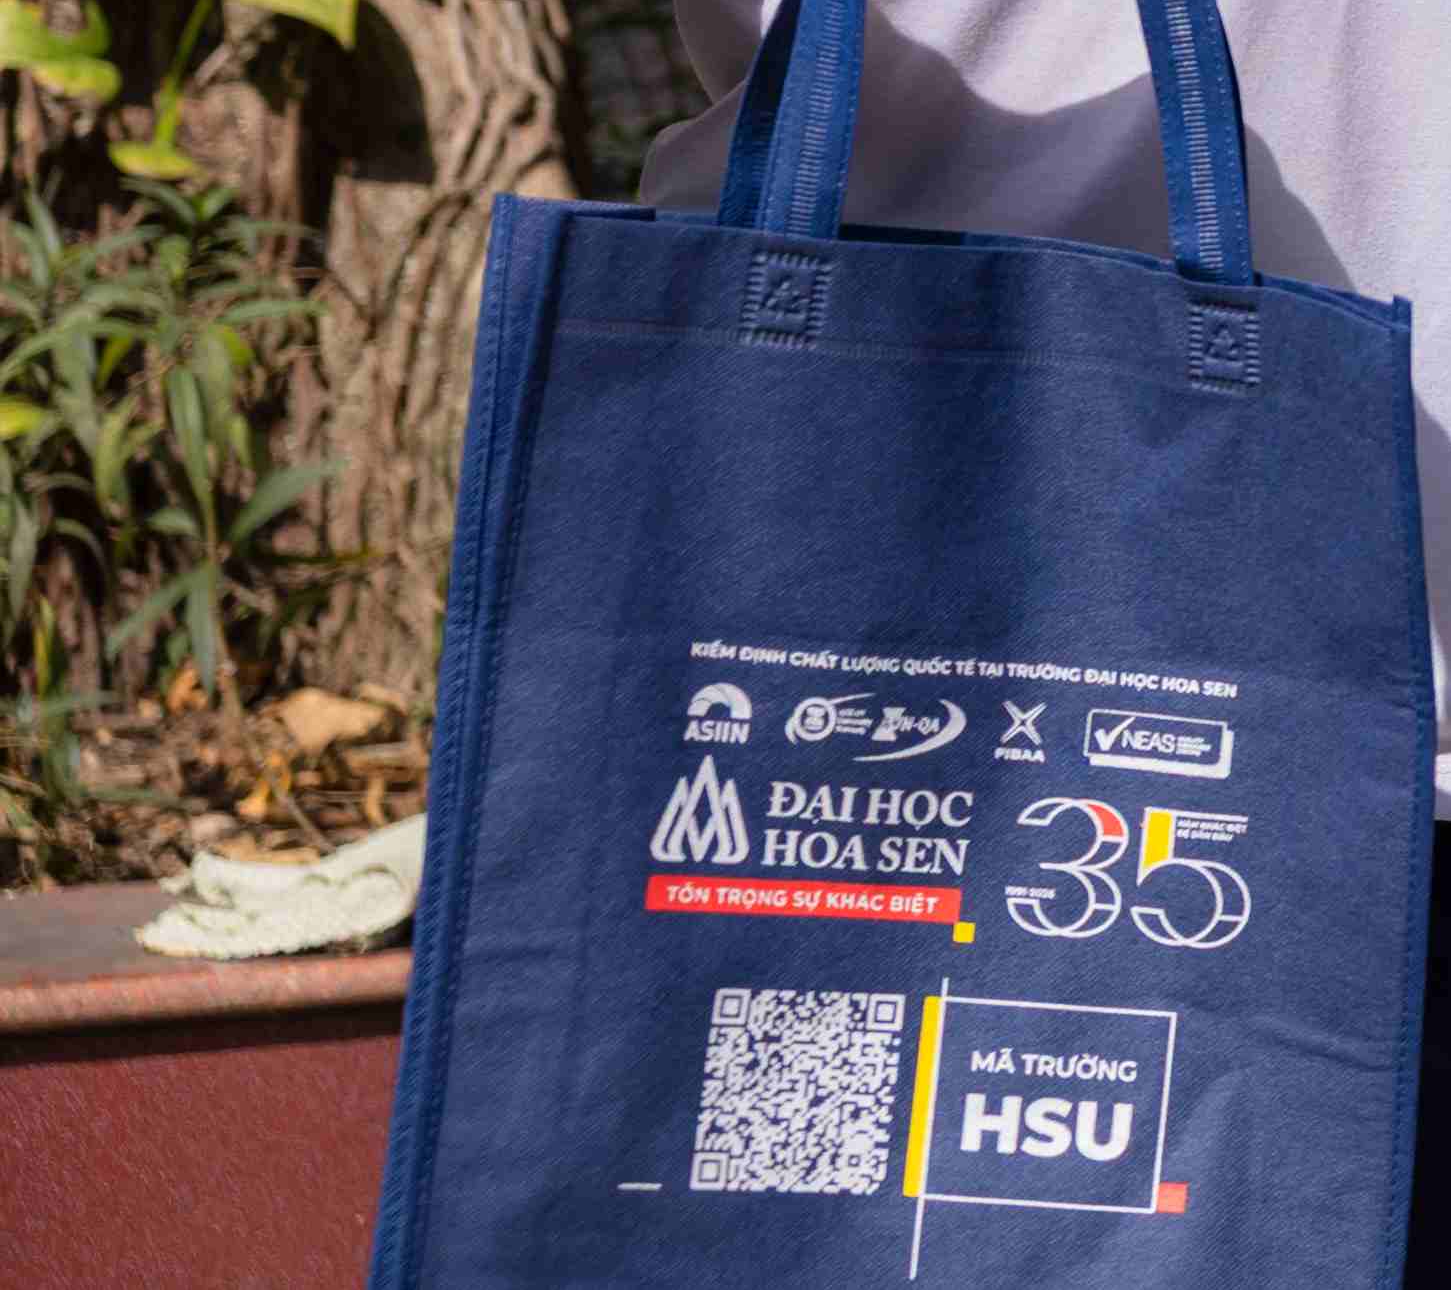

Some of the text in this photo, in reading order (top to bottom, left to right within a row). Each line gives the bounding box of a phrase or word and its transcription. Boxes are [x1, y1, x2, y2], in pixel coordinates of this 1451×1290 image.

[789, 650, 840, 670] CHẤT
[841, 655, 900, 675] LƯỢNG
[902, 654, 953, 676] QUỐC
[955, 658, 978, 676] TẾ
[979, 661, 1004, 679] TẠI
[1006, 662, 1081, 683] TRƯỜNG
[1084, 667, 1118, 687] ĐẠI
[1120, 672, 1160, 692] HỌC
[1161, 676, 1201, 695] HOA
[1203, 681, 1239, 699] SEN
[684, 721, 750, 744] ASIIN
[1121, 730, 1175, 753] NEAS
[766, 781, 974, 831] ĐẠI HỌC
[761, 829, 971, 876] HOA SEN
[667, 881, 710, 905] TÔN
[716, 886, 788, 910] TRỌNG
[791, 887, 823, 911] SỰ
[890, 893, 941, 915] BIỆT
[970, 1047, 1138, 1082] MÃ TRƯỜNG
[960, 1092, 1134, 1161] HSU
